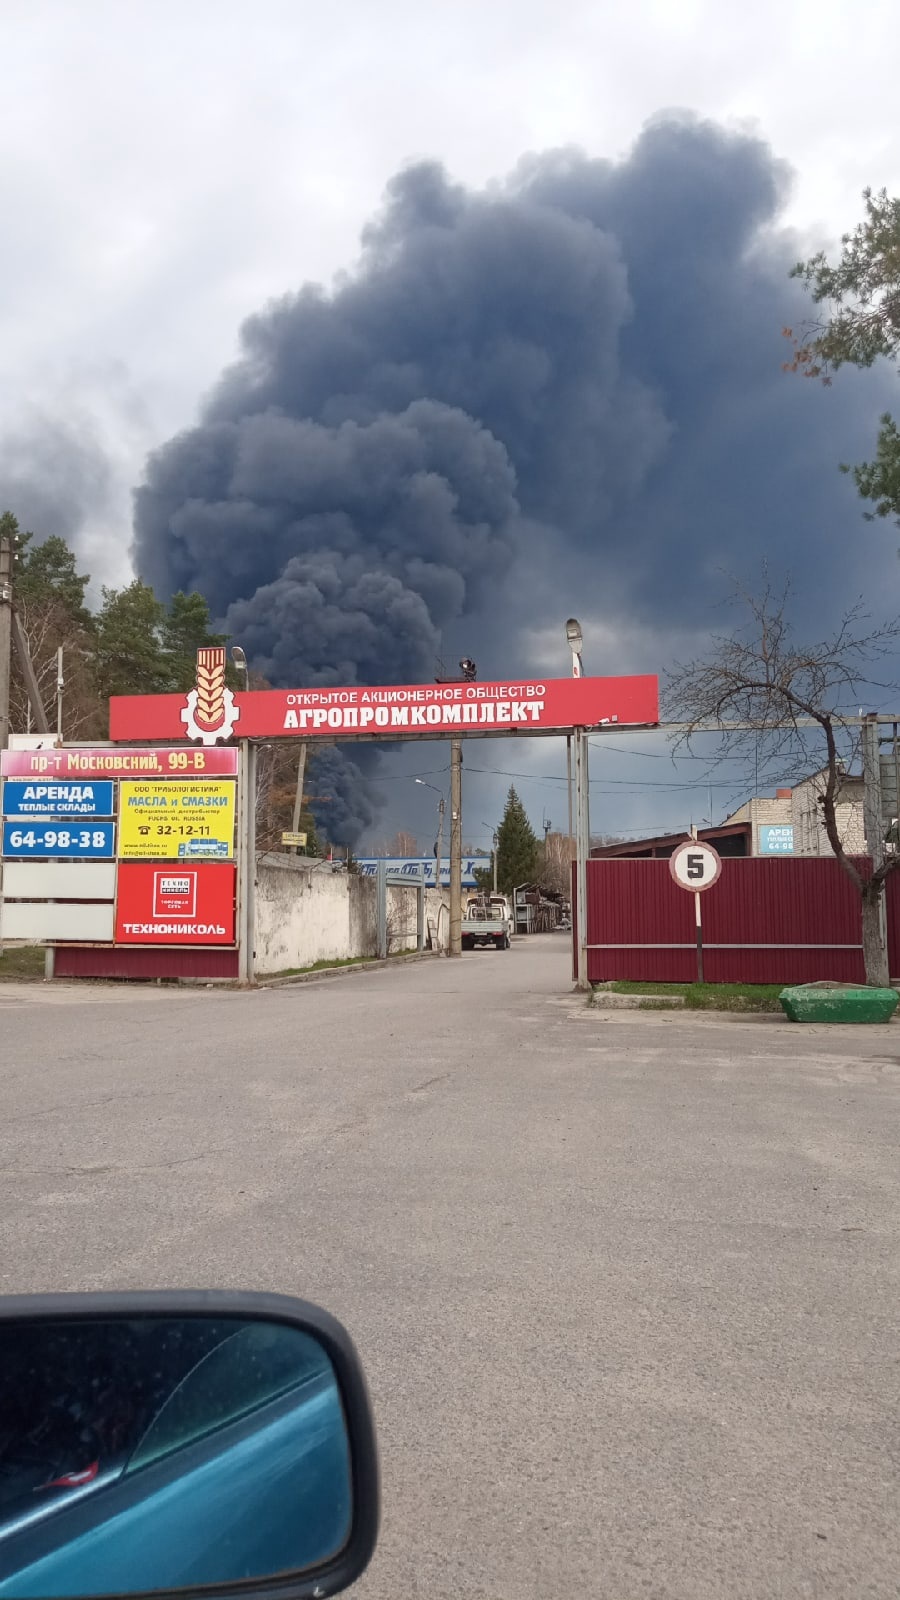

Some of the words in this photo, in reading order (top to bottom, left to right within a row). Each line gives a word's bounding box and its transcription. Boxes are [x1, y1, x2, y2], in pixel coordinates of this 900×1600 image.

[286, 691, 358, 706] ОТКРЫТОЕ
[361, 688, 463, 704] АКЦИОНЕРНОЕ
[466, 684, 546, 701] ОБЩЕСТВО
[283, 700, 545, 729] АГРОПРОМКОМПЛЕКТ
[30, 755, 61, 773] пр-т
[67, 753, 164, 773] Московский,
[168, 752, 206, 770] 99-В
[22, 786, 94, 802] АРЕНДА
[127, 796, 167, 806] МАСЛА
[171, 798, 178, 806] и
[181, 796, 228, 806] СМАЗКИ
[18, 803, 56, 812] ТЕПЛЫЕ
[56, 803, 96, 813] СКЛАДЫ
[9, 830, 106, 848] 64-98-38
[156, 825, 211, 836] 32-12-11
[687, 854, 704, 879] 5
[122, 923, 226, 935] ТЕХНОНИКОЛЬ
